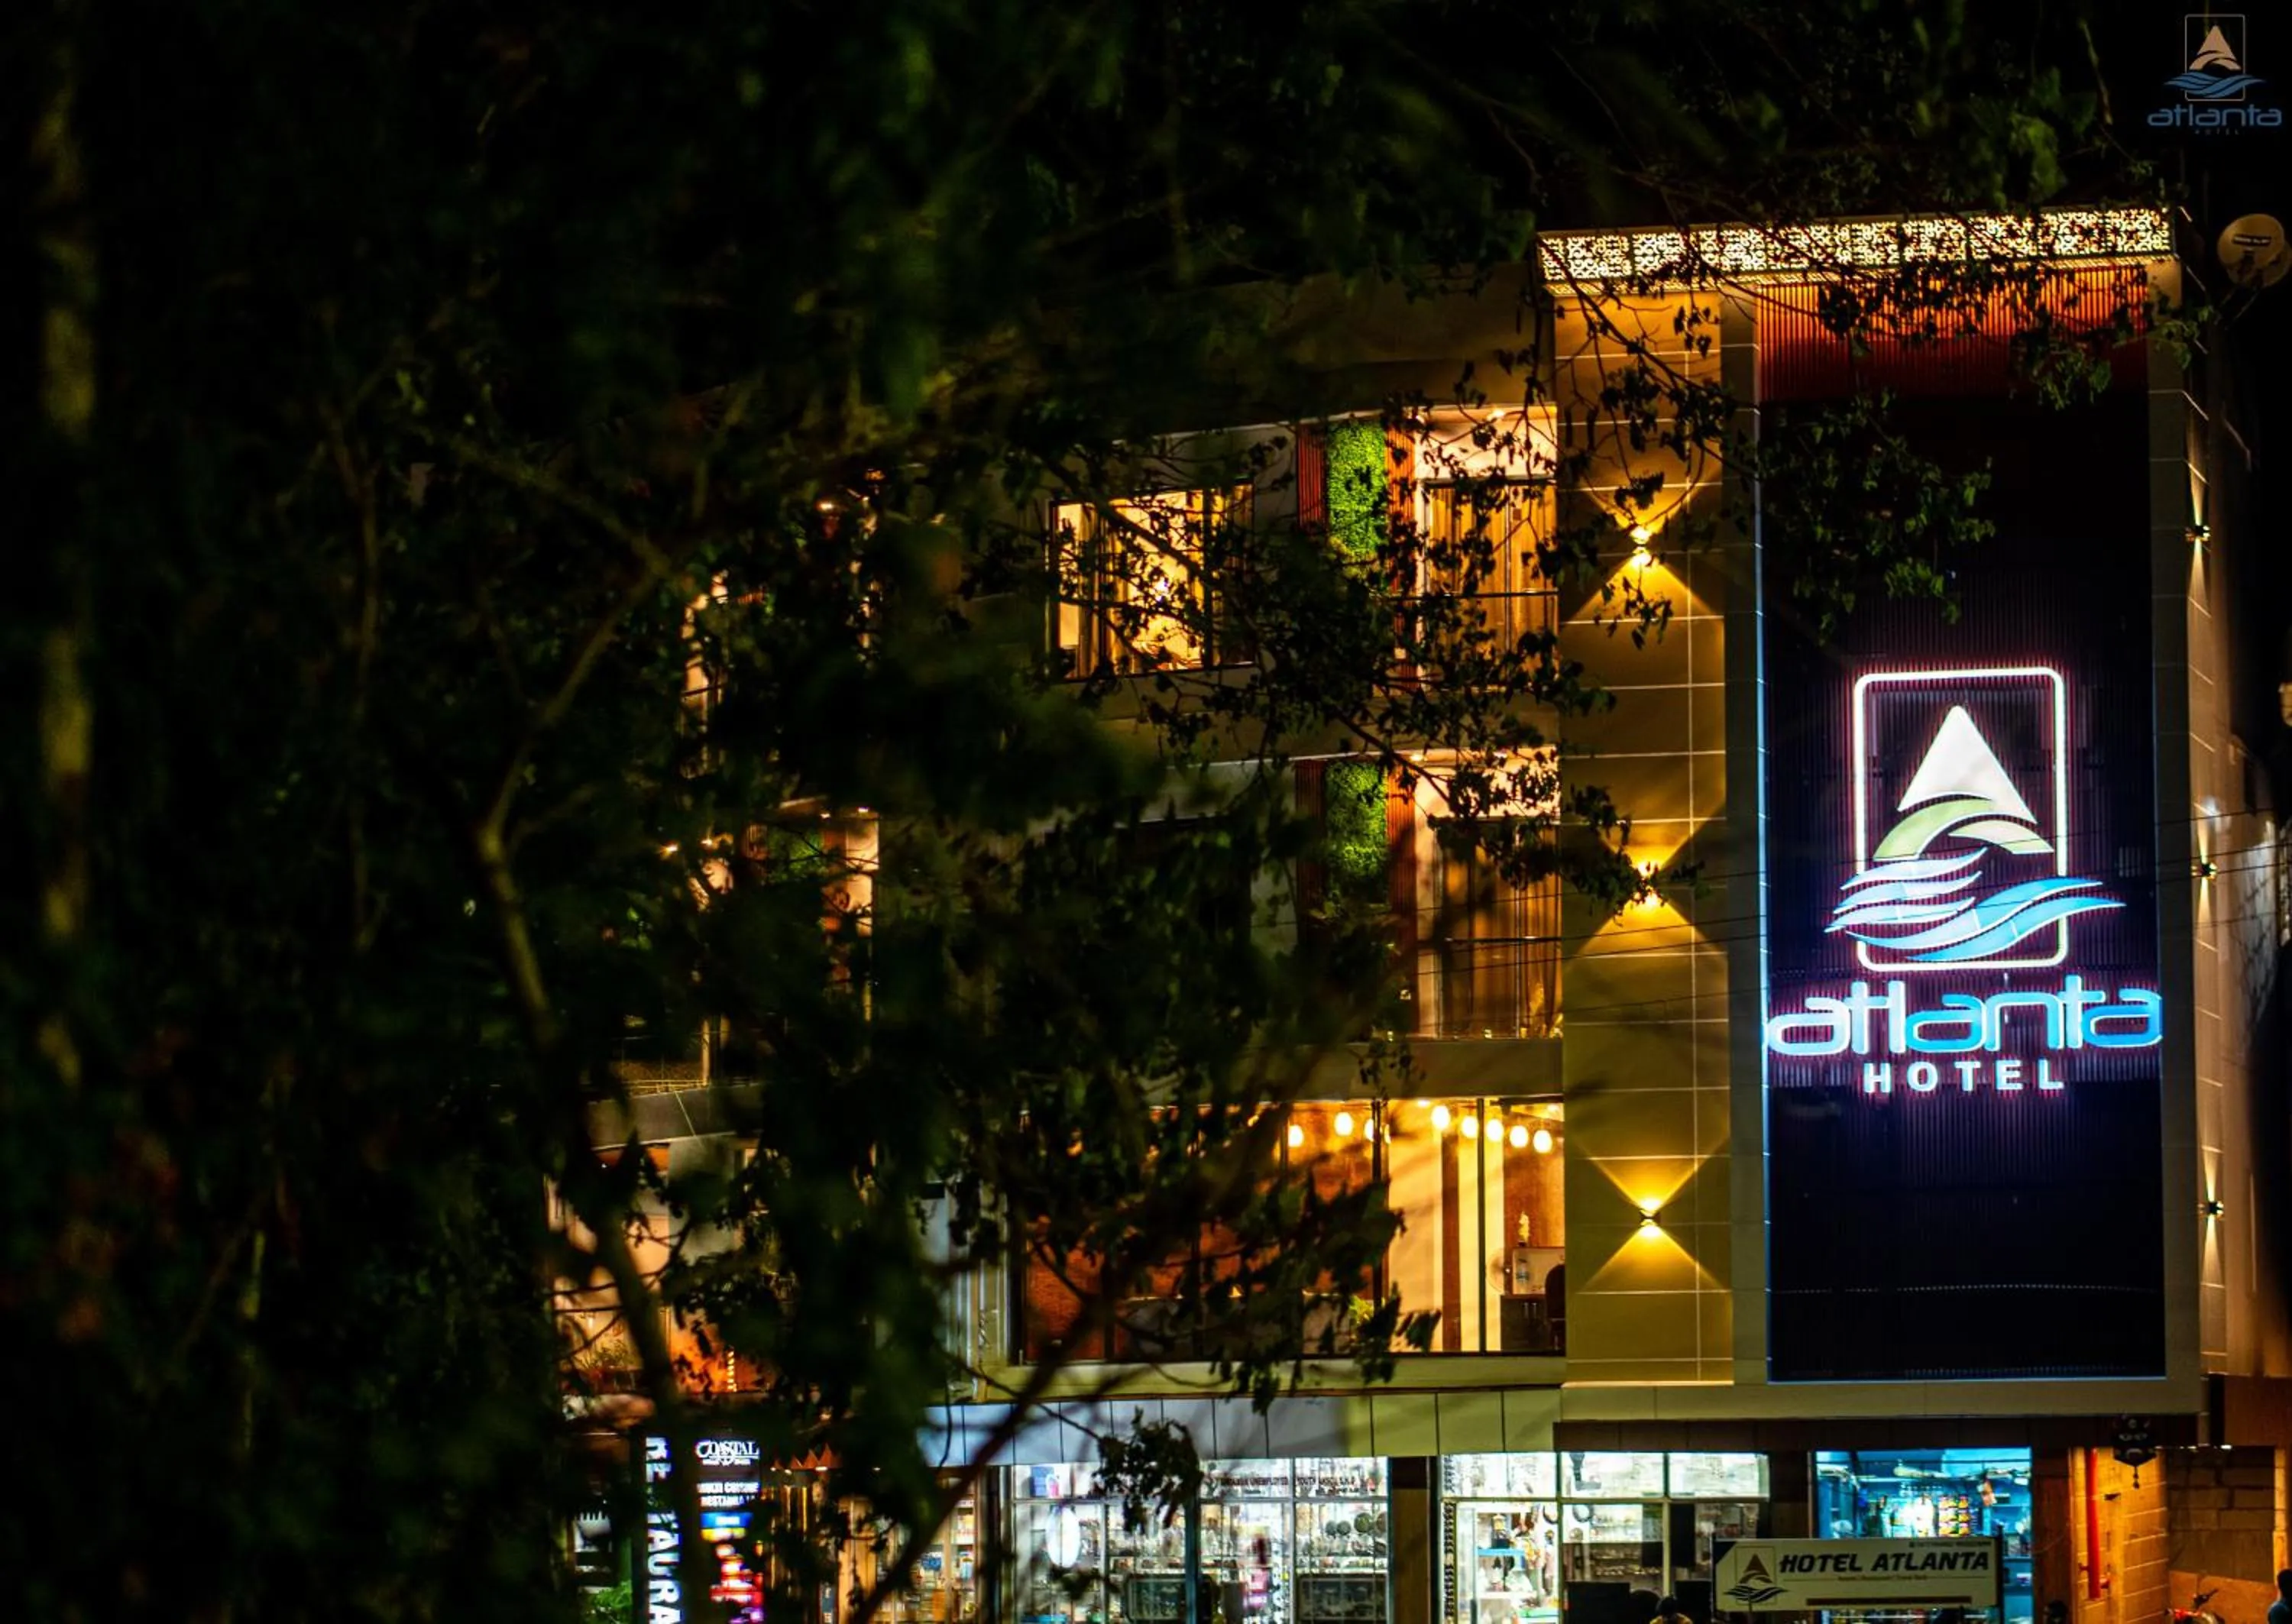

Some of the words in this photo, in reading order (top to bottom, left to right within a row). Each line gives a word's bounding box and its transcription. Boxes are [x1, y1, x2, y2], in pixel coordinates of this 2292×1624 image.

[1766, 974, 2163, 1056] atlanta
[1863, 1058, 2065, 1093] HOTEL
[1779, 1553, 1863, 1574] HOTEL
[1870, 1551, 1989, 1572] ATLANTA
